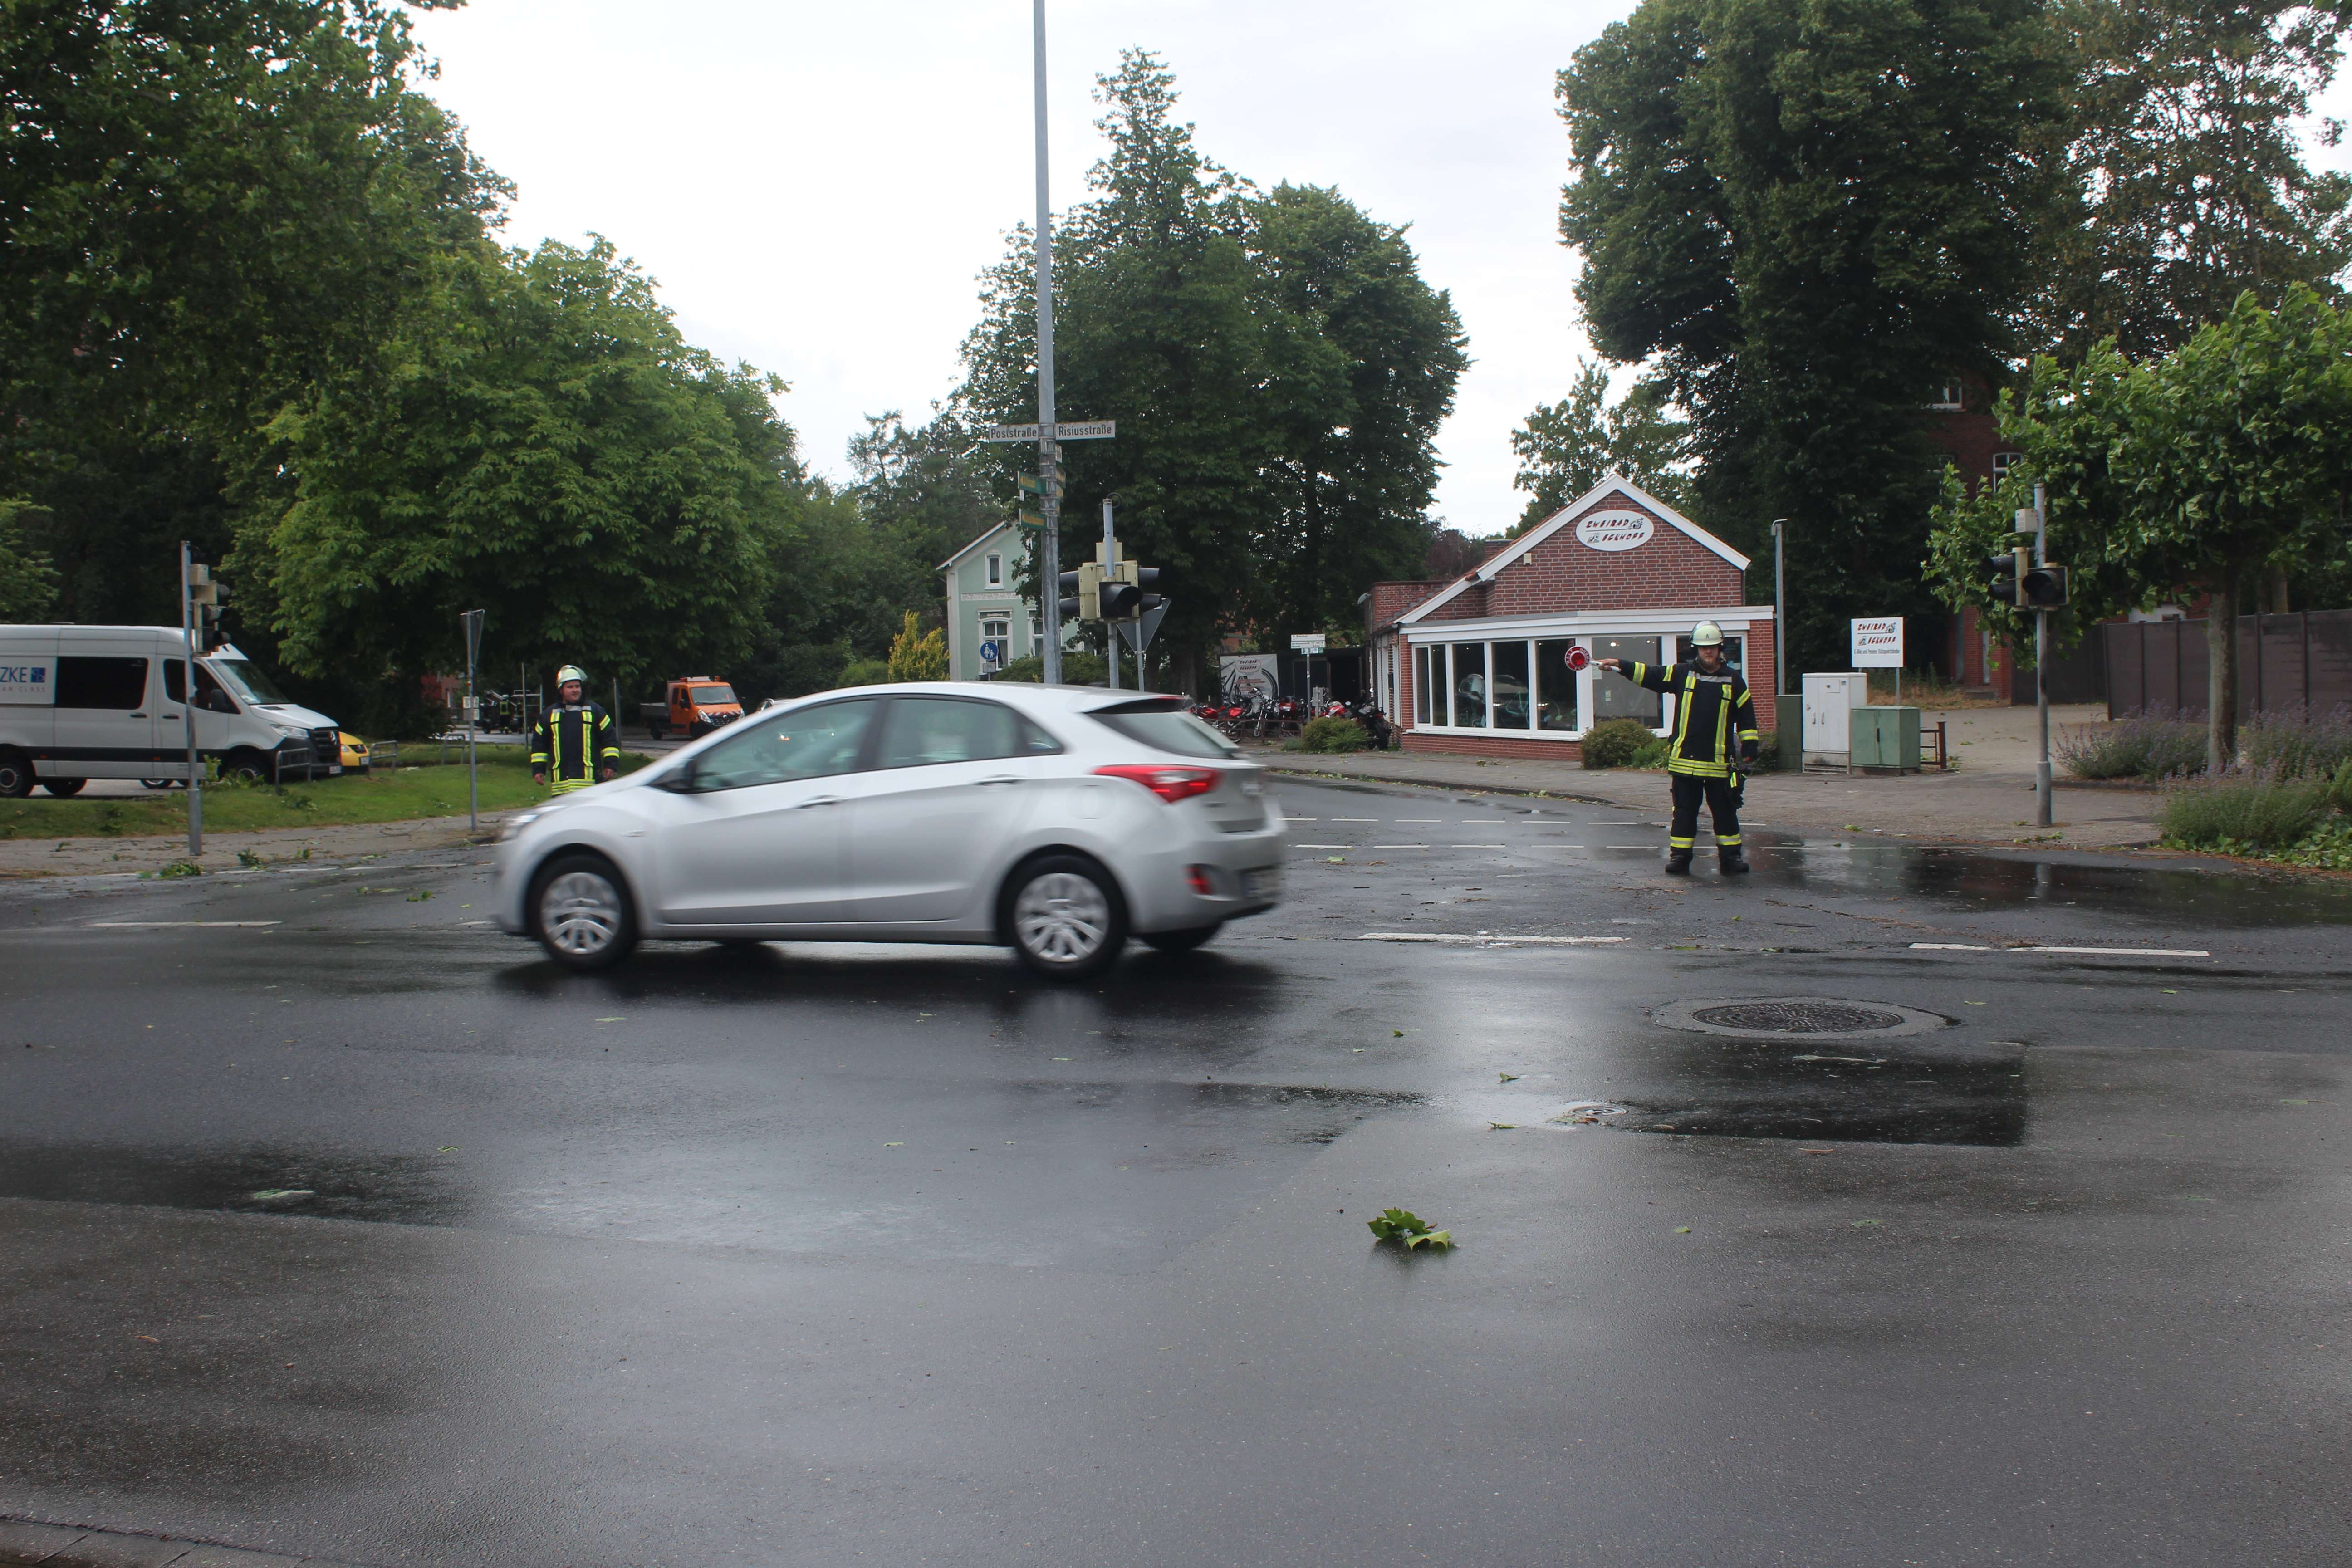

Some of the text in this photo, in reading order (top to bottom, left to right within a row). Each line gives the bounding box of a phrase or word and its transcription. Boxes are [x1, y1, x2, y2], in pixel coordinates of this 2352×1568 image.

[991, 427, 1037, 439] Poststraße
[1058, 425, 1112, 436] Risiusstraße
[1586, 519, 1630, 528] ZWEIRAD
[1601, 532, 1645, 542] ECKHOFF
